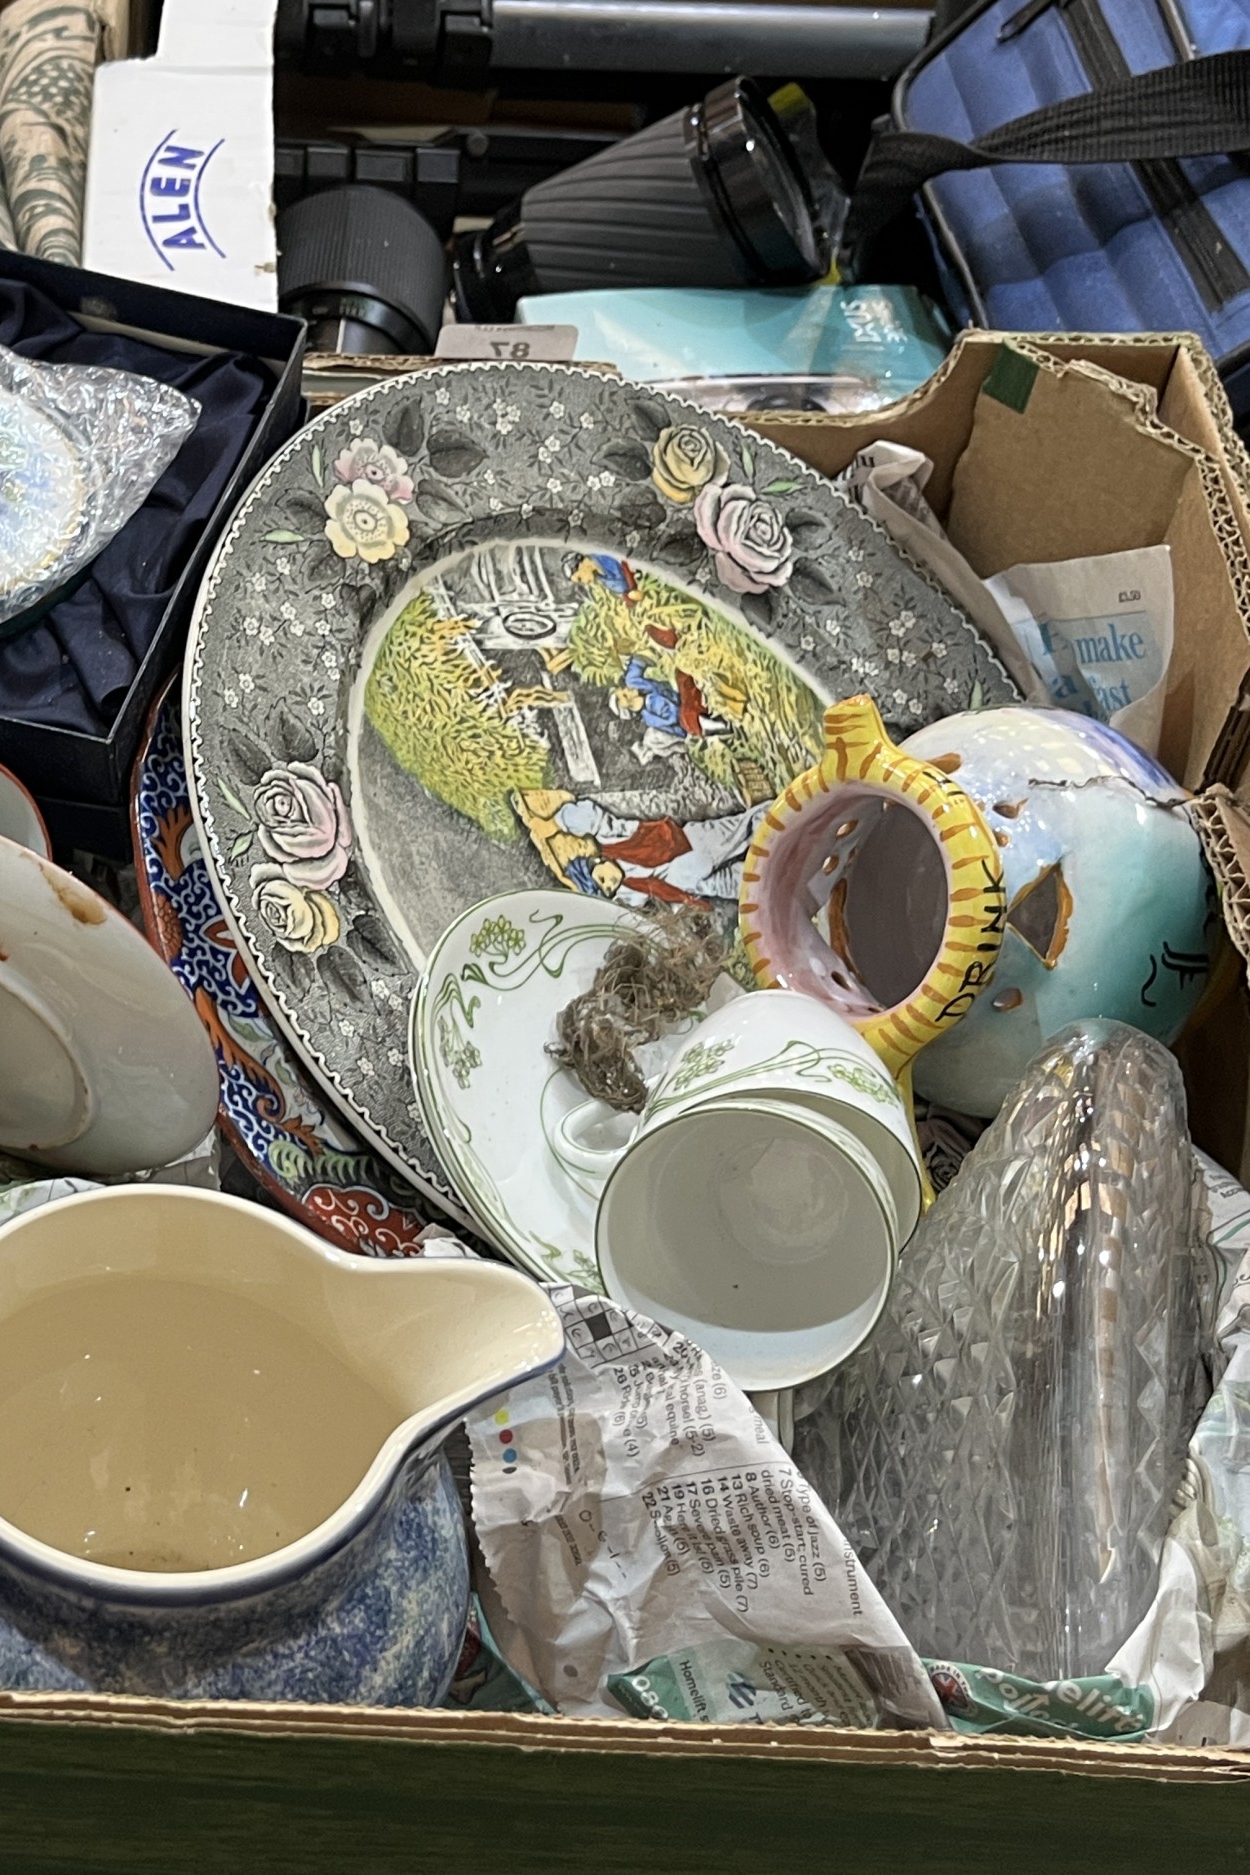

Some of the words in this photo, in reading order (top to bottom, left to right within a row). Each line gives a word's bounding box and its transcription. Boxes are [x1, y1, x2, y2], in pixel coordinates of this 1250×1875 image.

[151, 145, 206, 251] ALEN
[1075, 624, 1145, 664] make
[935, 858, 1007, 1022] DRINK
[693, 1379, 711, 1420] (anag.)
[712, 1383, 727, 1399] (6)
[684, 1426, 705, 1456] (5-2)
[700, 1424, 717, 1441] (5)
[672, 1484, 684, 1499] 19
[686, 1482, 698, 1495] 17
[701, 1479, 714, 1495] 16
[718, 1477, 729, 1492] 14
[732, 1474, 743, 1490] 13
[746, 1473, 757, 1482] 8
[657, 1486, 670, 1501] 21
[735, 1493, 754, 1522] Rich
[749, 1486, 772, 1527] Author
[677, 1503, 691, 1532] Here
[689, 1499, 712, 1540] Severe
[705, 1498, 726, 1536] Dried
[723, 1494, 741, 1536] Waste
[761, 1470, 780, 1503] dried
[773, 1507, 791, 1539] meat
[782, 1543, 795, 1562] (5)
[806, 1516, 818, 1528] of
[642, 1492, 656, 1509] 22
[664, 1560, 680, 1576] (5)
[748, 1524, 765, 1554] soup
[766, 1531, 780, 1549] (6)
[807, 1531, 819, 1558] jazz
[705, 1543, 725, 1566] pain
[716, 1536, 739, 1564] grass
[736, 1538, 753, 1568] away
[718, 1570, 731, 1588] (5)
[731, 1567, 744, 1591] pile
[746, 1572, 758, 1589] (7)
[758, 1559, 769, 1577] (6)
[799, 1555, 814, 1595] cured
[812, 1562, 826, 1581] (5)
[736, 1595, 748, 1612] (7)
[679, 1659, 707, 1715] Homelift
[759, 1660, 793, 1712] Standard
[775, 1659, 806, 1706] Certified
